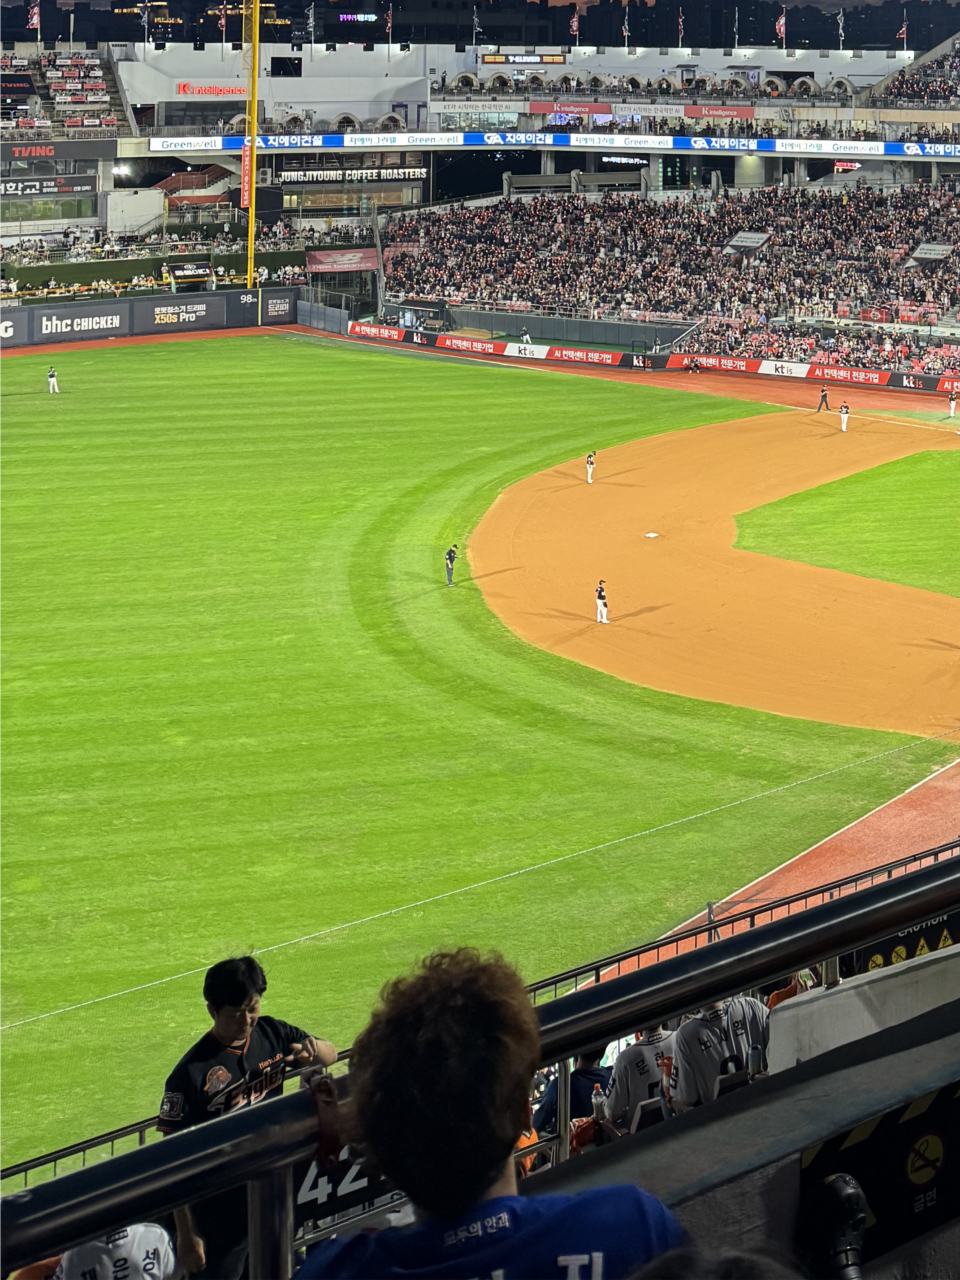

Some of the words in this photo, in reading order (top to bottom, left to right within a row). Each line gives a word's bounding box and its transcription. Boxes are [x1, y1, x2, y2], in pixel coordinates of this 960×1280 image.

[178, 83, 191, 95] K
[193, 85, 247, 96] intelligence
[702, 107, 709, 115] K
[506, 133, 553, 145] 지에이건설
[711, 138, 758, 150] 지에이건설
[12, 145, 55, 157] TVING
[278, 171, 343, 183] JUNGJIYOUNG
[345, 170, 378, 181] COFFEE
[381, 168, 427, 179] ROASTERS
[187, 304, 206, 312] 드리미
[41, 316, 72, 334] bhc
[73, 315, 120, 331] CHICKEN
[154, 313, 178, 324] X50s
[179, 313, 196, 323] Pro
[518, 345, 527, 356] kt
[587, 352, 612, 363] 전문기업
[633, 355, 644, 366] kt
[720, 358, 746, 370] 전문기업
[774, 363, 785, 374] kt
[786, 367, 793, 375] is
[815, 368, 822, 376] AI
[824, 368, 850, 380] 컨택센터
[852, 371, 879, 383] 전문기업
[902, 375, 915, 388] kt
[915, 380, 923, 389] is
[913, 1187, 938, 1214] 금연
[484, 1211, 510, 1234] 안과
